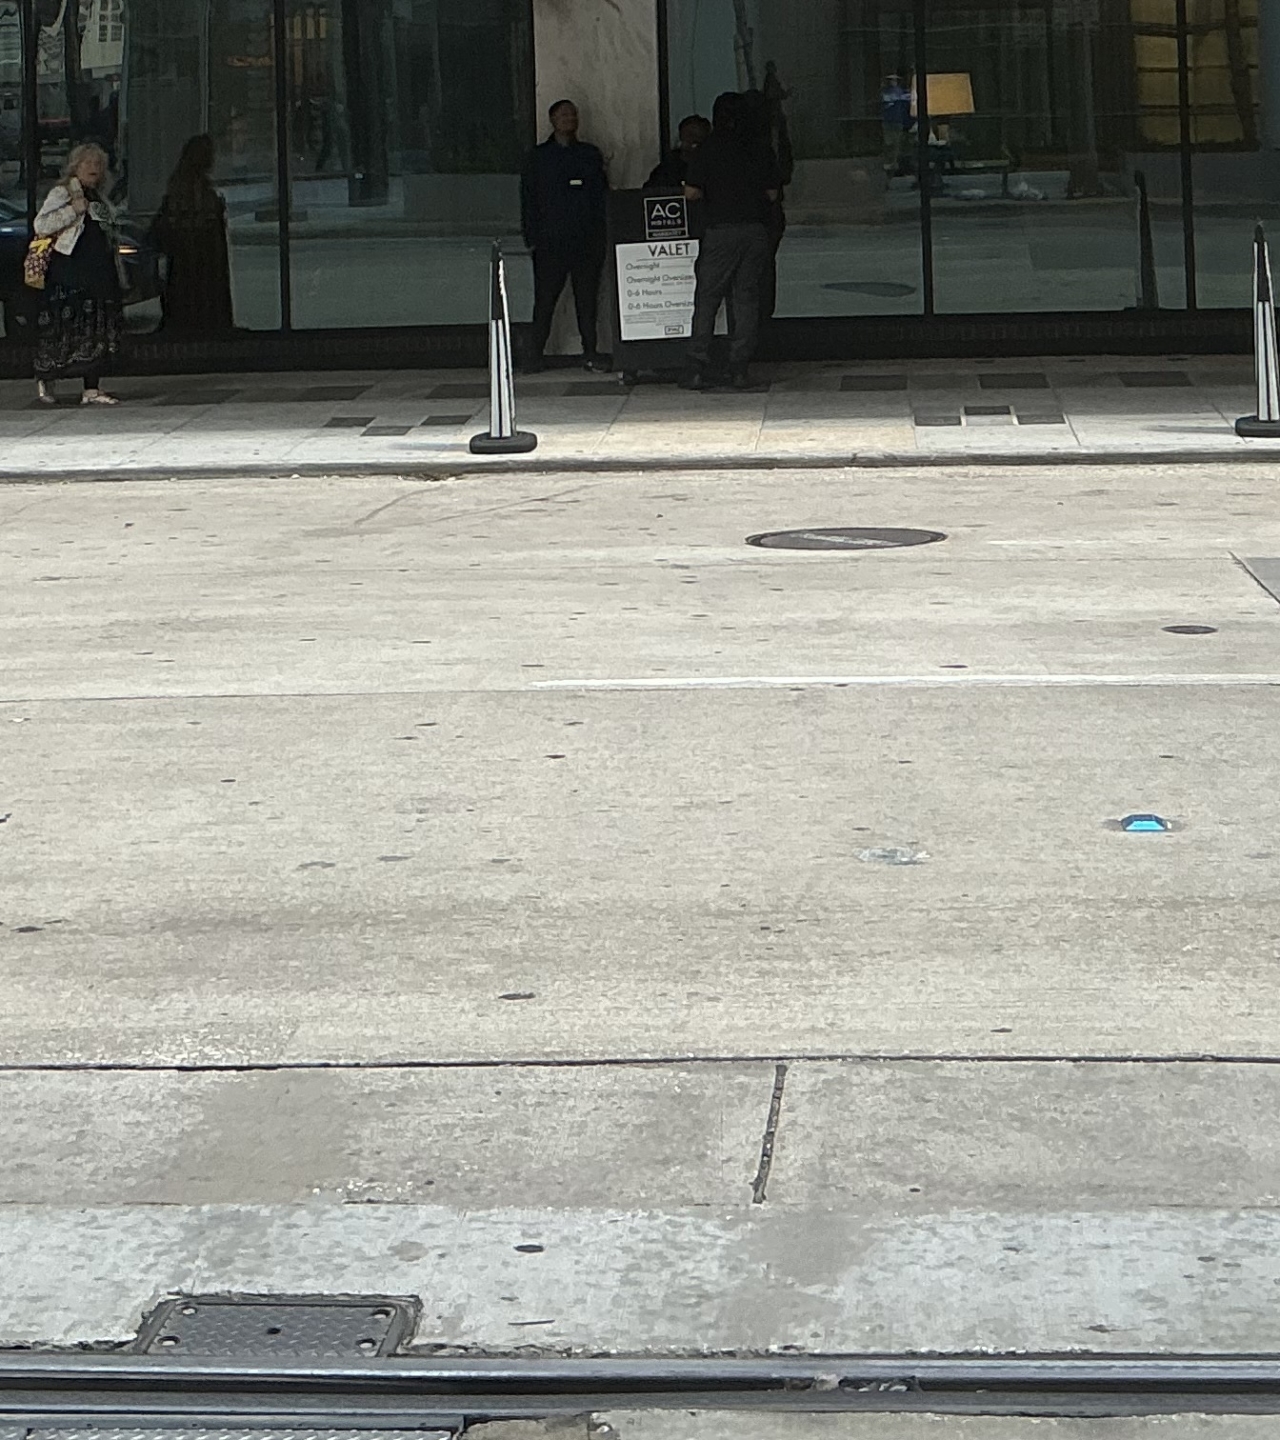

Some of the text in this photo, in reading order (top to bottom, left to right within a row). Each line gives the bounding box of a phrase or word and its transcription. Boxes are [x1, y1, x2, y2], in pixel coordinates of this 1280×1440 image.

[651, 201, 681, 220] AC
[647, 242, 691, 257] VALET
[625, 262, 660, 271] Overnight
